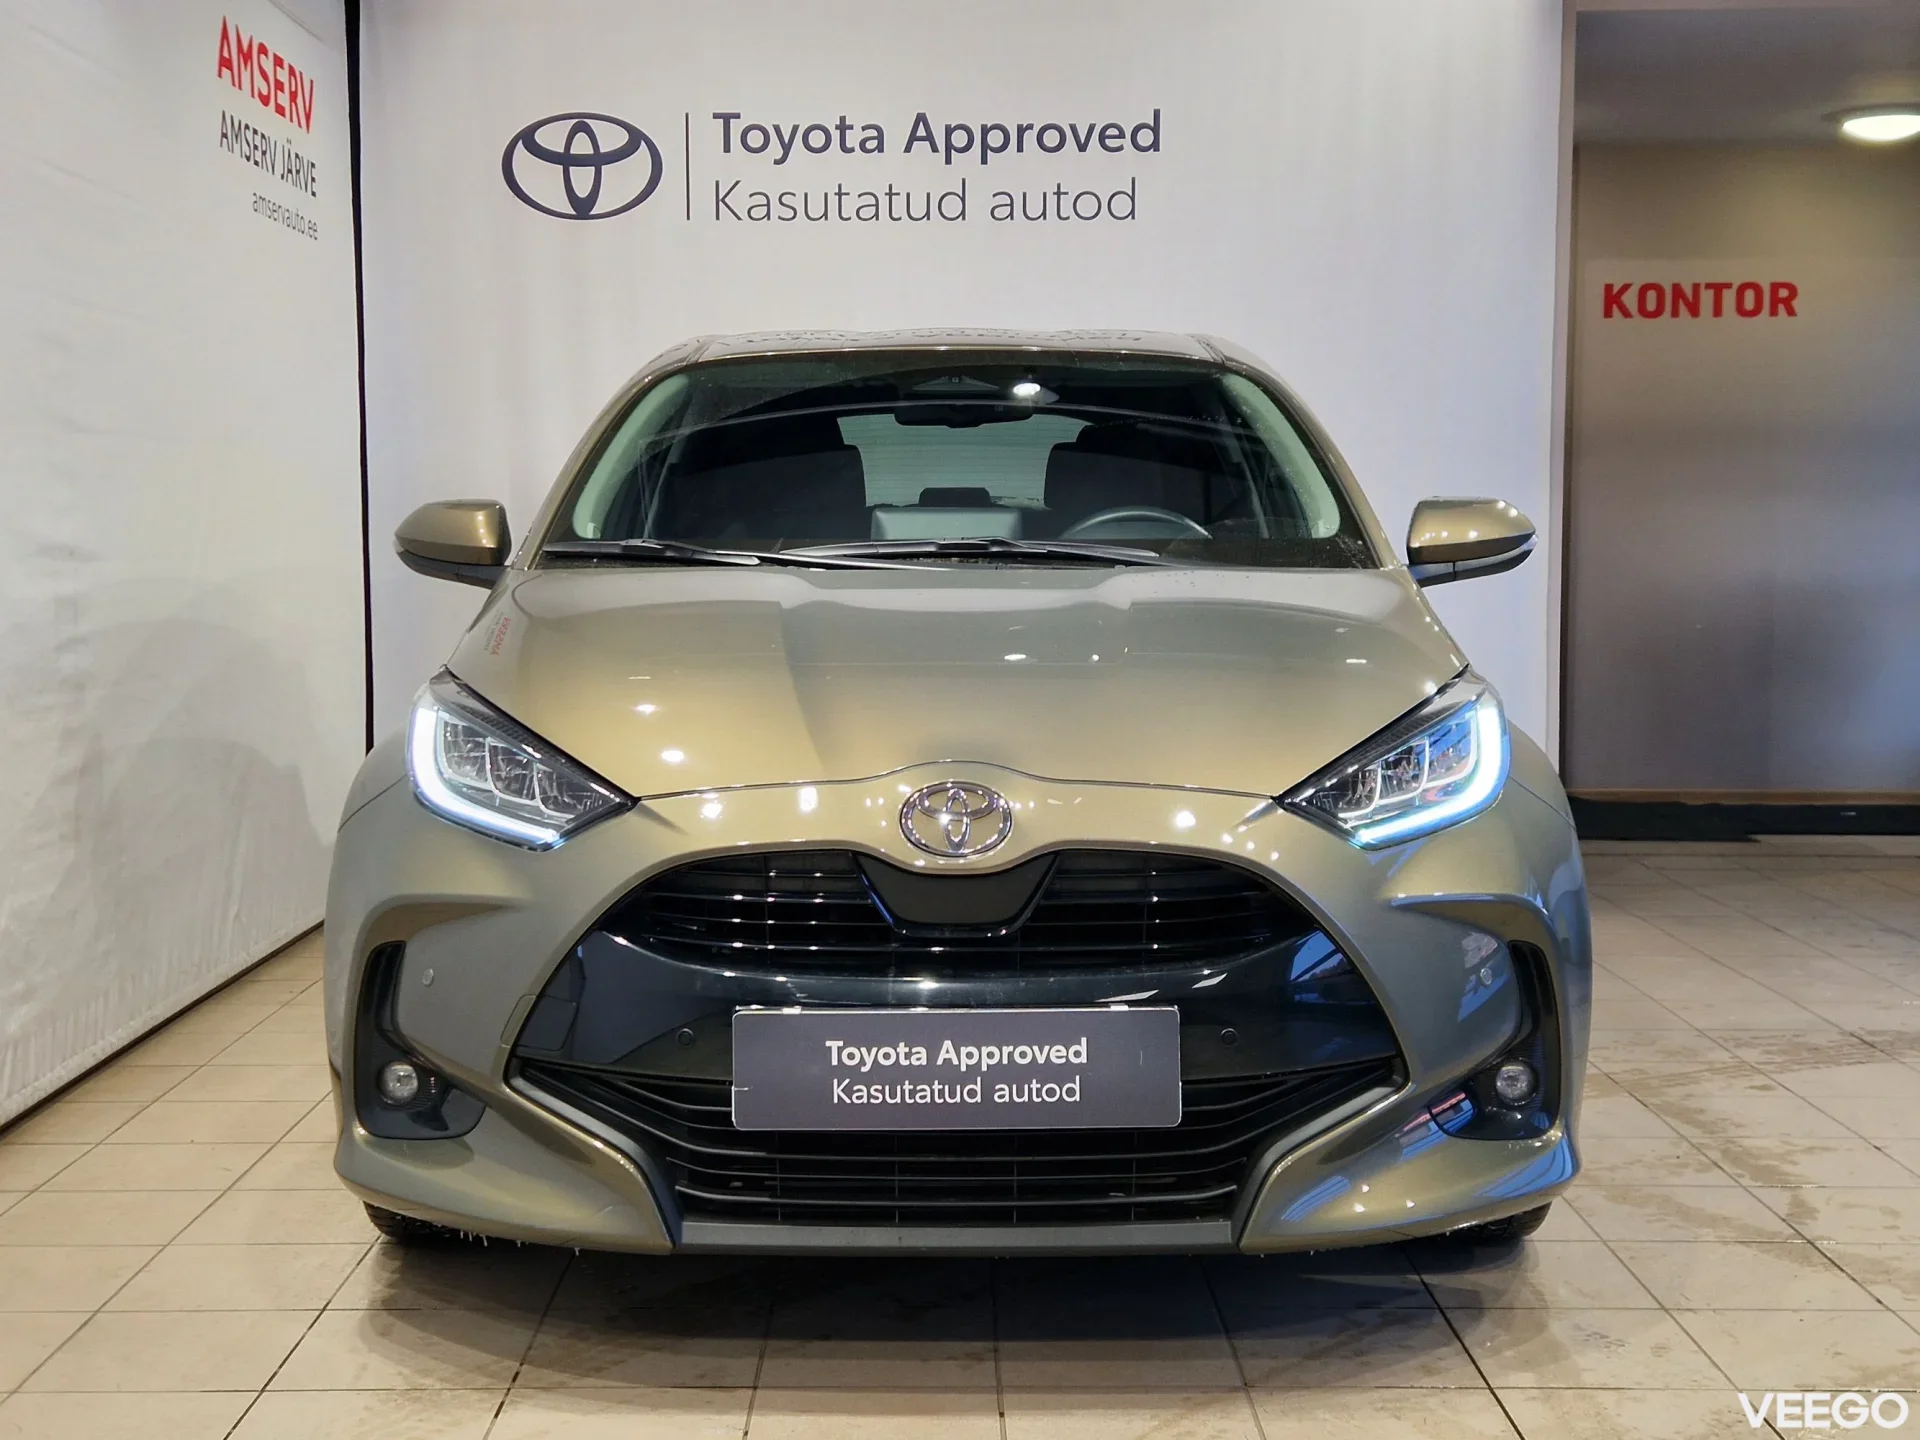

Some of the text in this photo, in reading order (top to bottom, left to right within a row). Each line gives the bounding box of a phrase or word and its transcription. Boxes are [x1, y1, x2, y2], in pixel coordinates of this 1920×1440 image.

[217, 15, 315, 134] AMSERV
[219, 110, 317, 198] AMSERV JÄRVE
[712, 109, 1161, 166] Toyota Approved
[252, 192, 319, 241] amservauto.ee
[713, 177, 1137, 222] Kasutatud autod
[1602, 281, 1799, 320] KONTOR
[825, 1037, 1088, 1072] Toyota Approved
[832, 1075, 1081, 1104] Kasutatud autod
